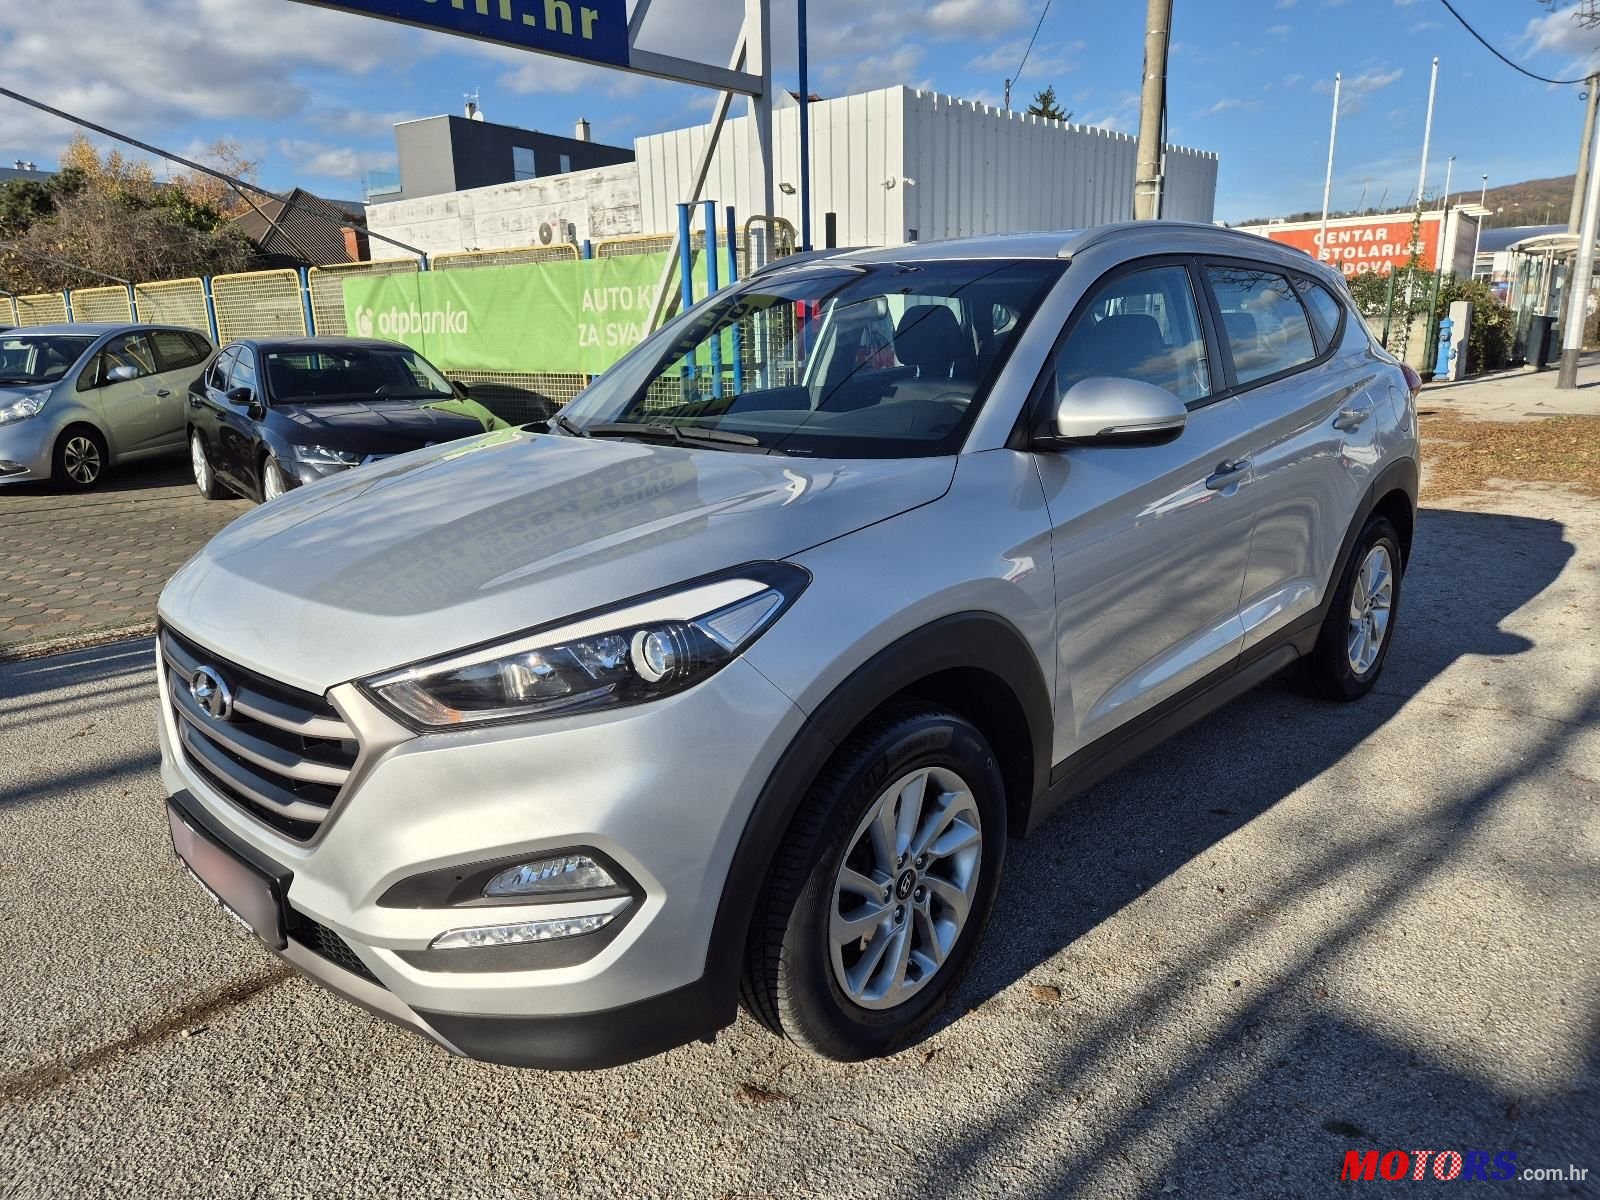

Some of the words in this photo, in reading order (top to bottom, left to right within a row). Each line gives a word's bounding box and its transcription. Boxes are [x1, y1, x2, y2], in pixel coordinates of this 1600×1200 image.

[1313, 228, 1387, 245] CENTAR
[1320, 241, 1425, 261] STOLARIJE
[582, 287, 633, 313] AUTO
[377, 300, 468, 343] otpbanka
[578, 324, 600, 347] ZA
